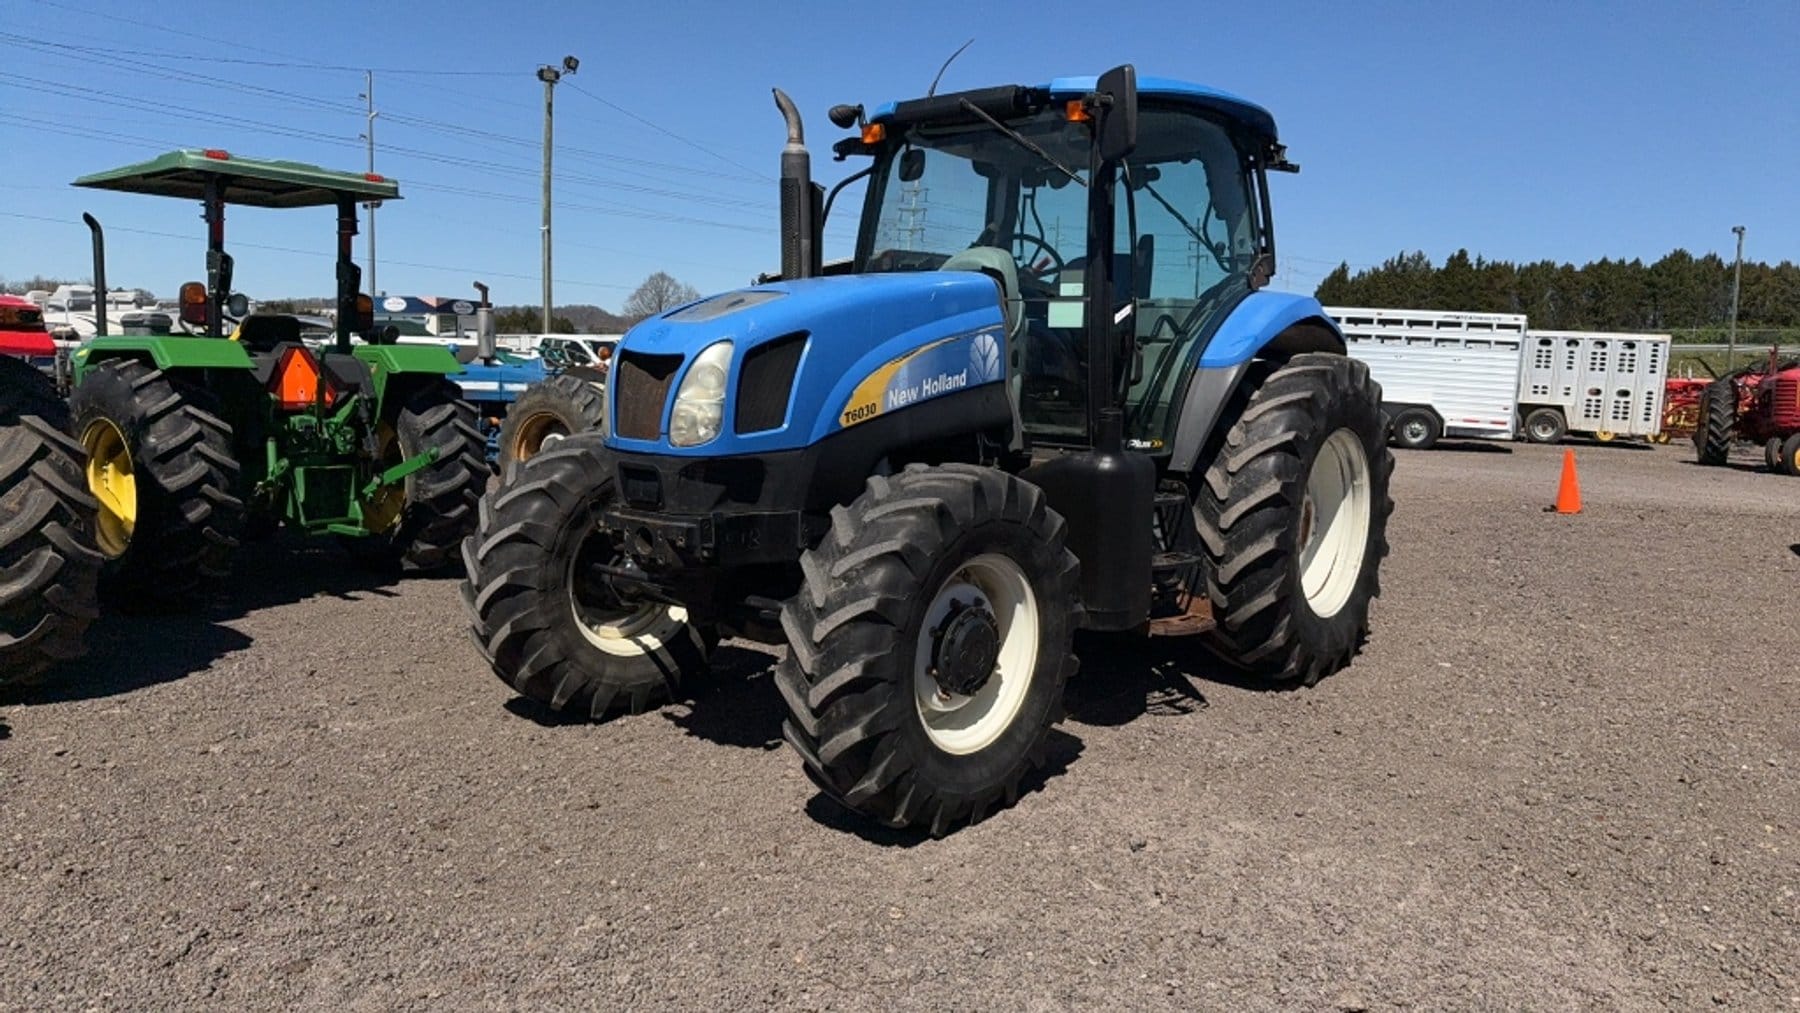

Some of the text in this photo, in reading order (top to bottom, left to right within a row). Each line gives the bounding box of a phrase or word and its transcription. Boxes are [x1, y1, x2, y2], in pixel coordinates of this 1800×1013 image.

[888, 369, 967, 407] New Holland
[844, 402, 877, 423] T6030
